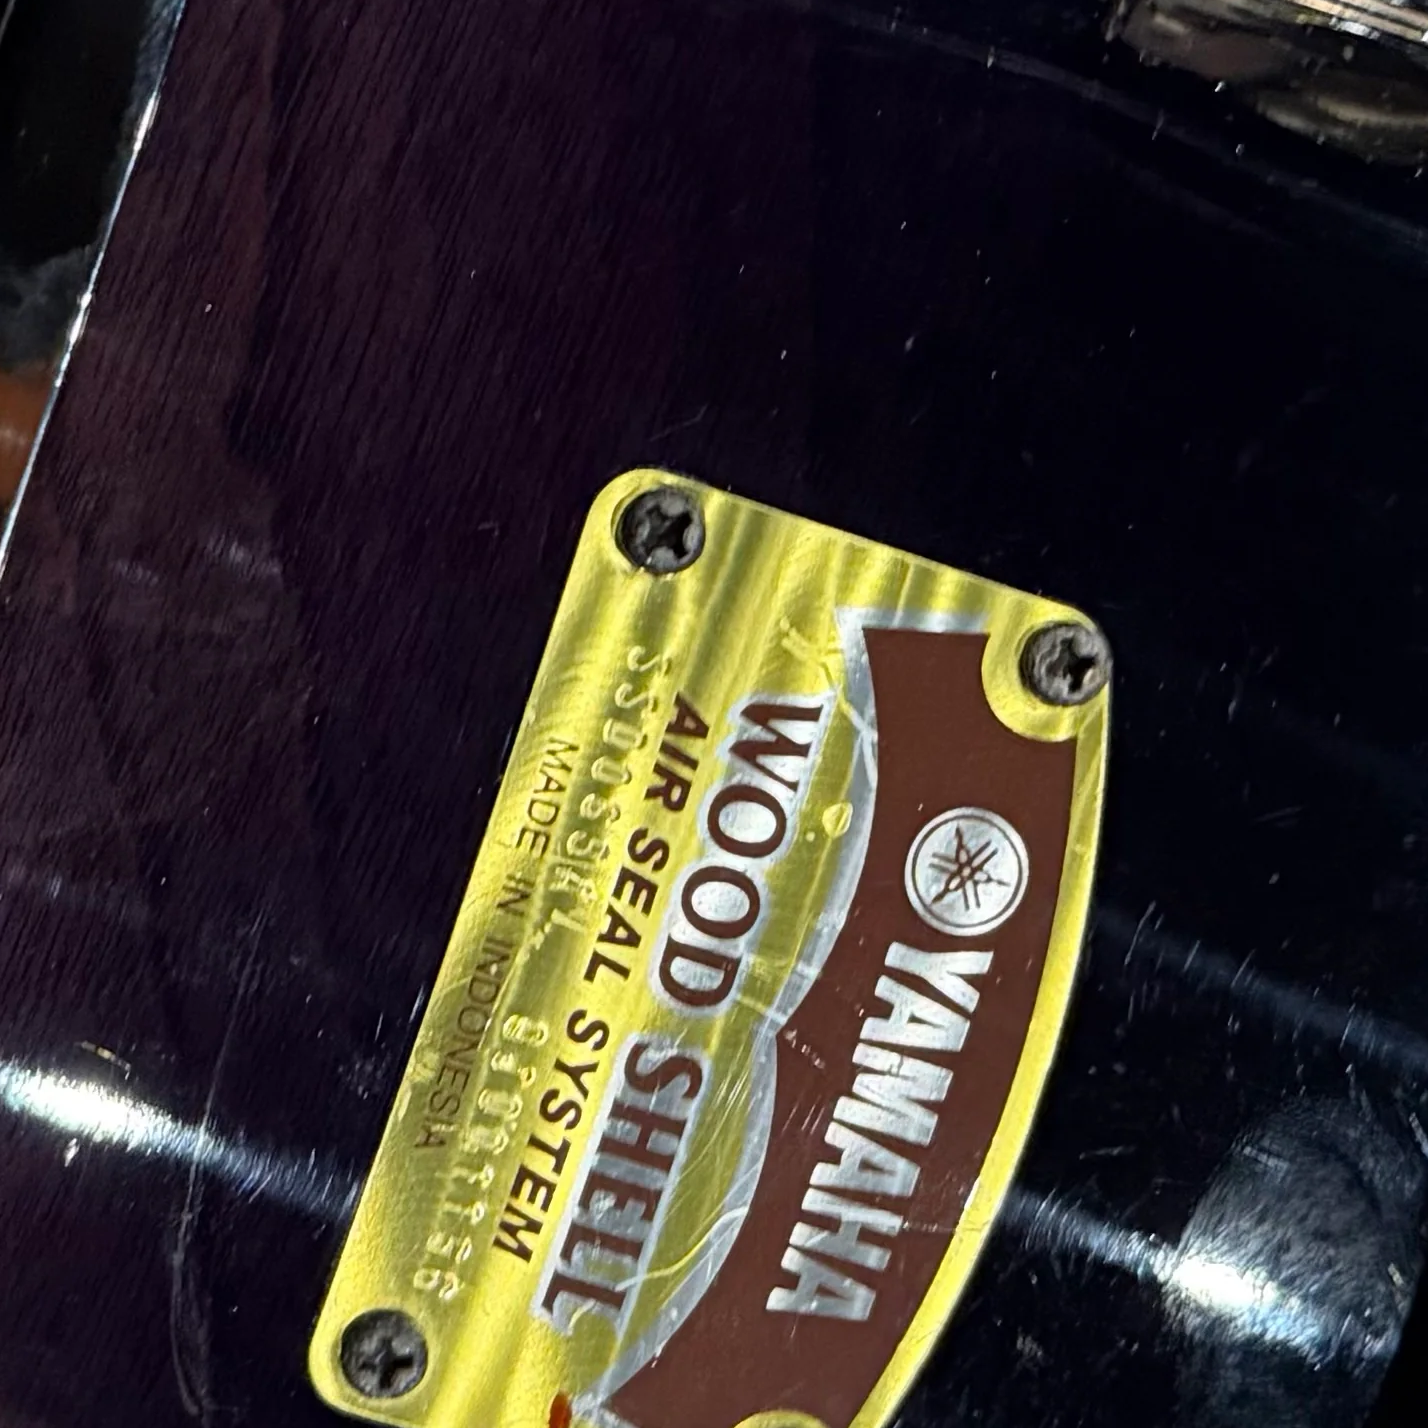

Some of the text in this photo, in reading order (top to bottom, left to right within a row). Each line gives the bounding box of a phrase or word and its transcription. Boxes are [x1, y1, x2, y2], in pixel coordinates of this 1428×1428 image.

[414, 735, 578, 1147] MADE IN INDONESIA
[490, 693, 708, 1263] AIR SEAL SYSTEM
[540, 695, 823, 1317] WOOD SHELL
[764, 951, 993, 1325] YAMAHA
